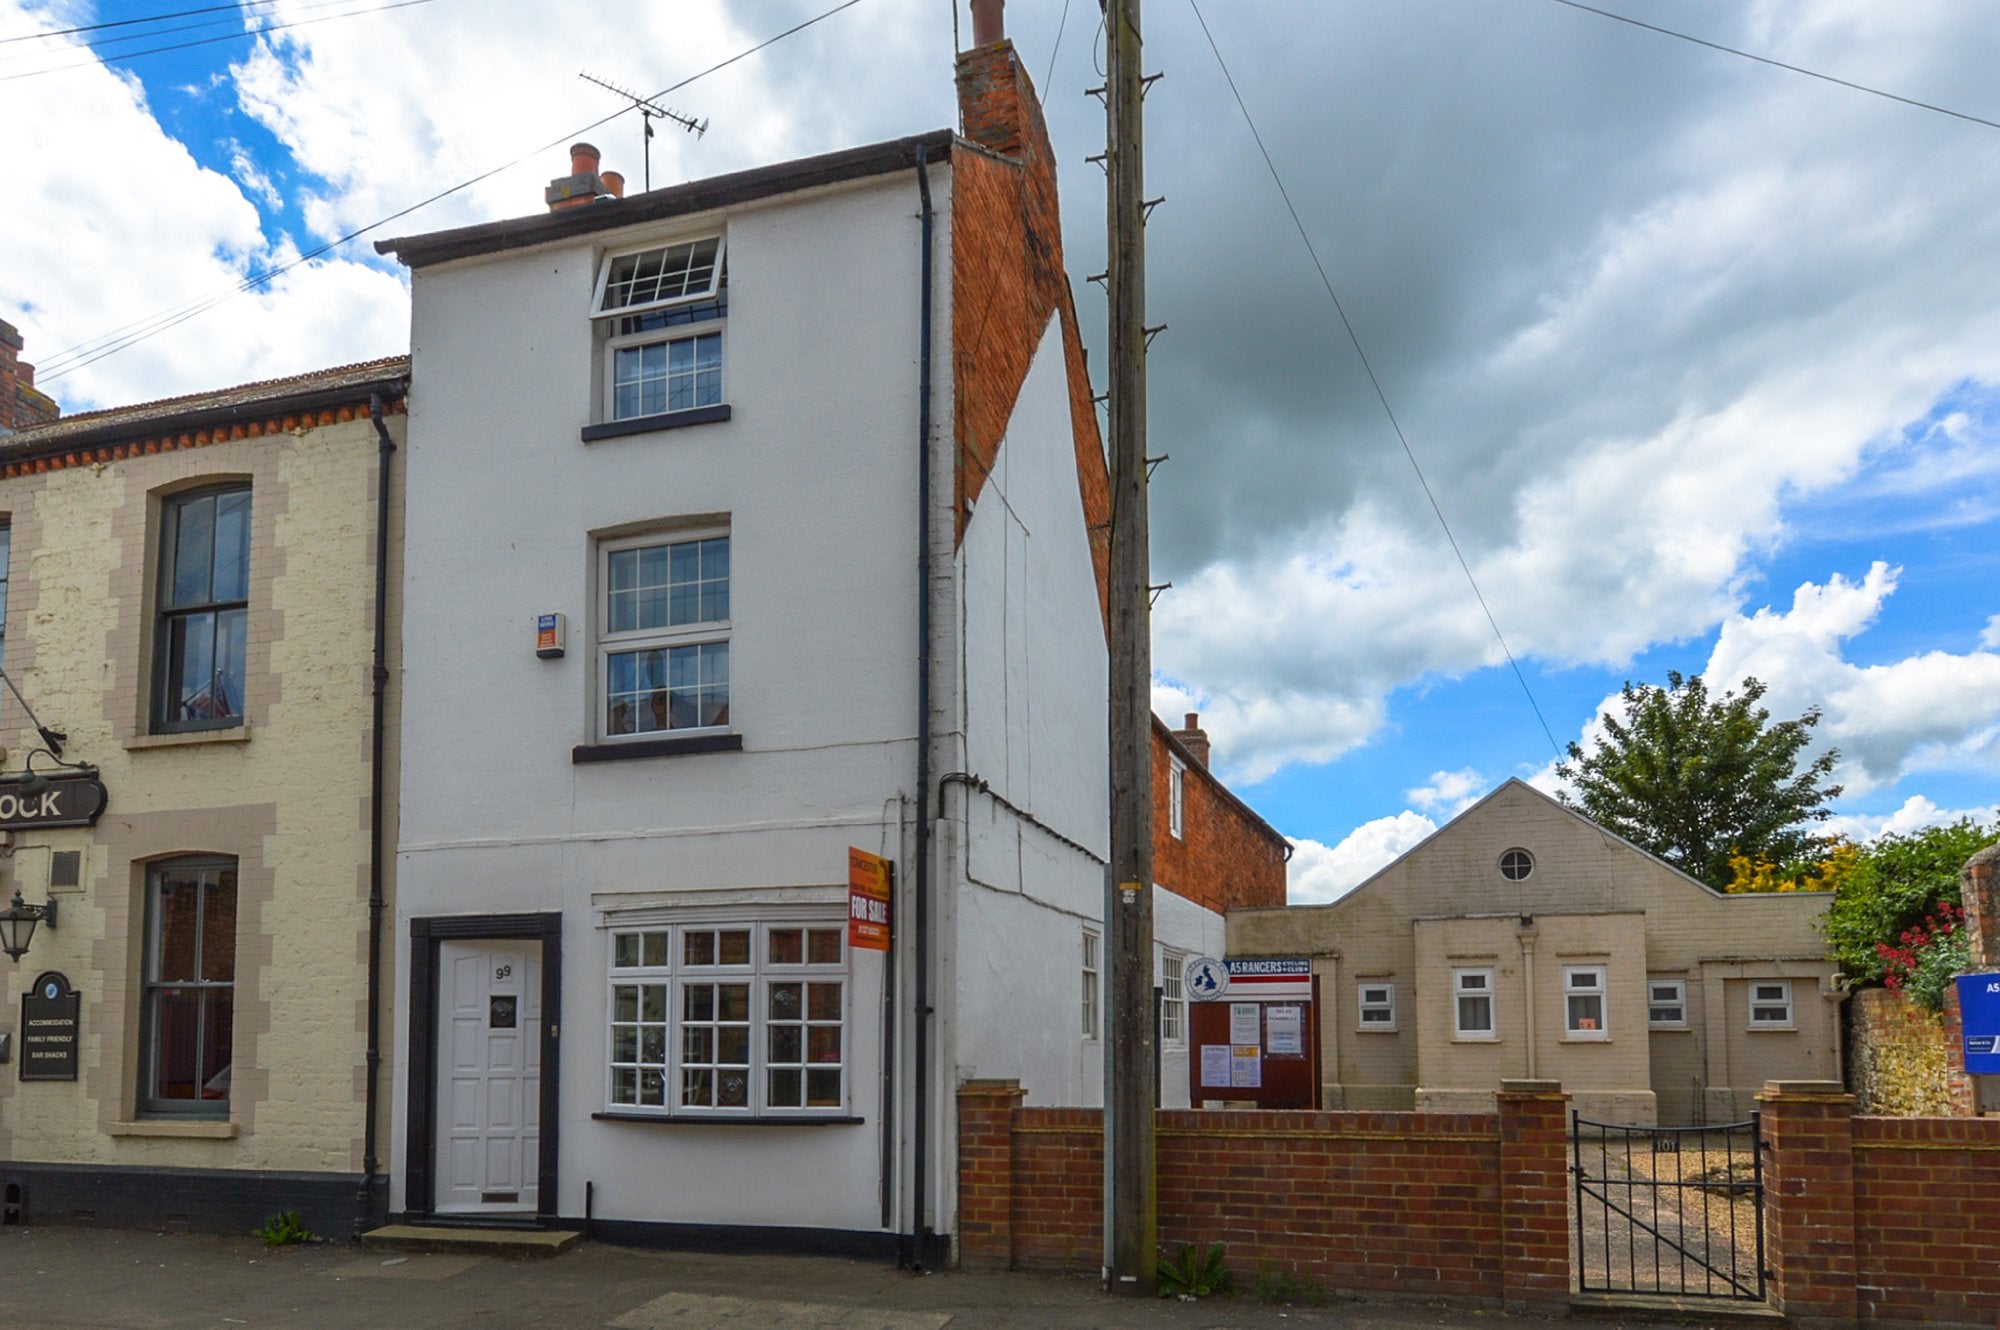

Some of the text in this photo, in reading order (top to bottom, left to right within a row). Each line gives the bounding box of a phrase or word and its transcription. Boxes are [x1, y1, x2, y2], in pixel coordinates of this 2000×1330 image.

[851, 895, 887, 924] FOR SALE
[496, 965, 511, 980] 99
[1242, 961, 1281, 973] RANGERS
[28, 1035, 73, 1043] FAMILY FRIENDLY
[31, 1051, 67, 1059] BAR SNACKS
[1656, 1139, 1676, 1152] 101
